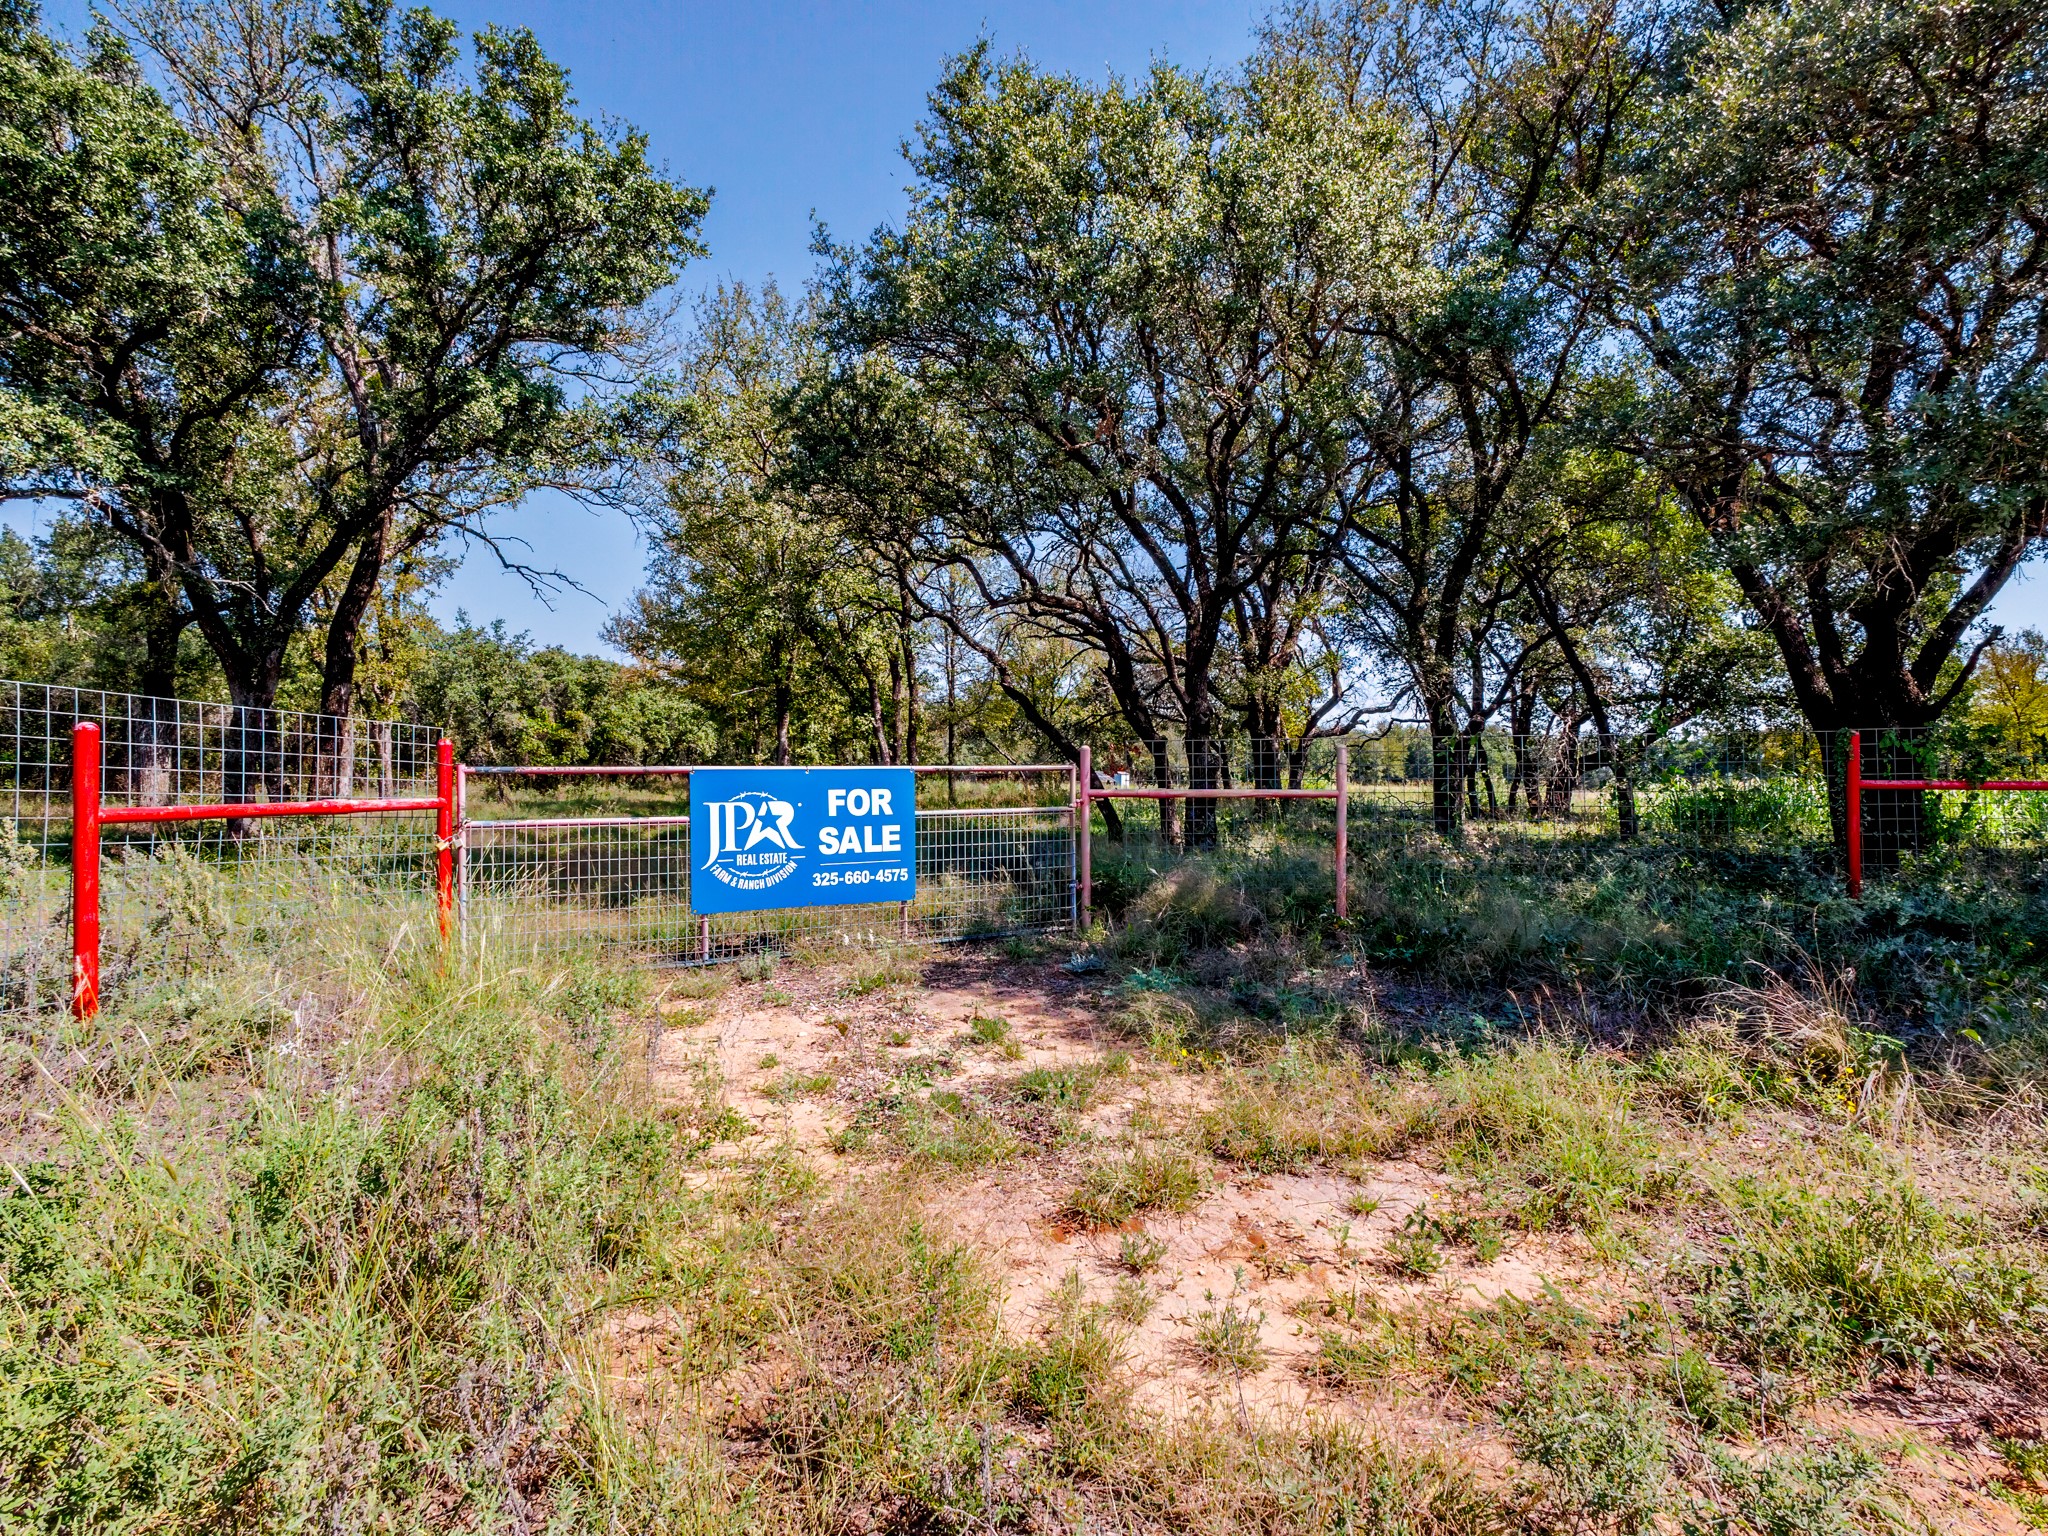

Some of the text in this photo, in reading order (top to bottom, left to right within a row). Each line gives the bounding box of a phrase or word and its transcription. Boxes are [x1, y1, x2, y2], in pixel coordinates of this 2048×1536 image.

[828, 788, 893, 817] FOR
[818, 824, 902, 855] SALE
[736, 852, 788, 866] REAL ESTATE
[709, 860, 798, 890] FARM & RANCH DIVISION
[812, 868, 909, 887] 325-660-4575
